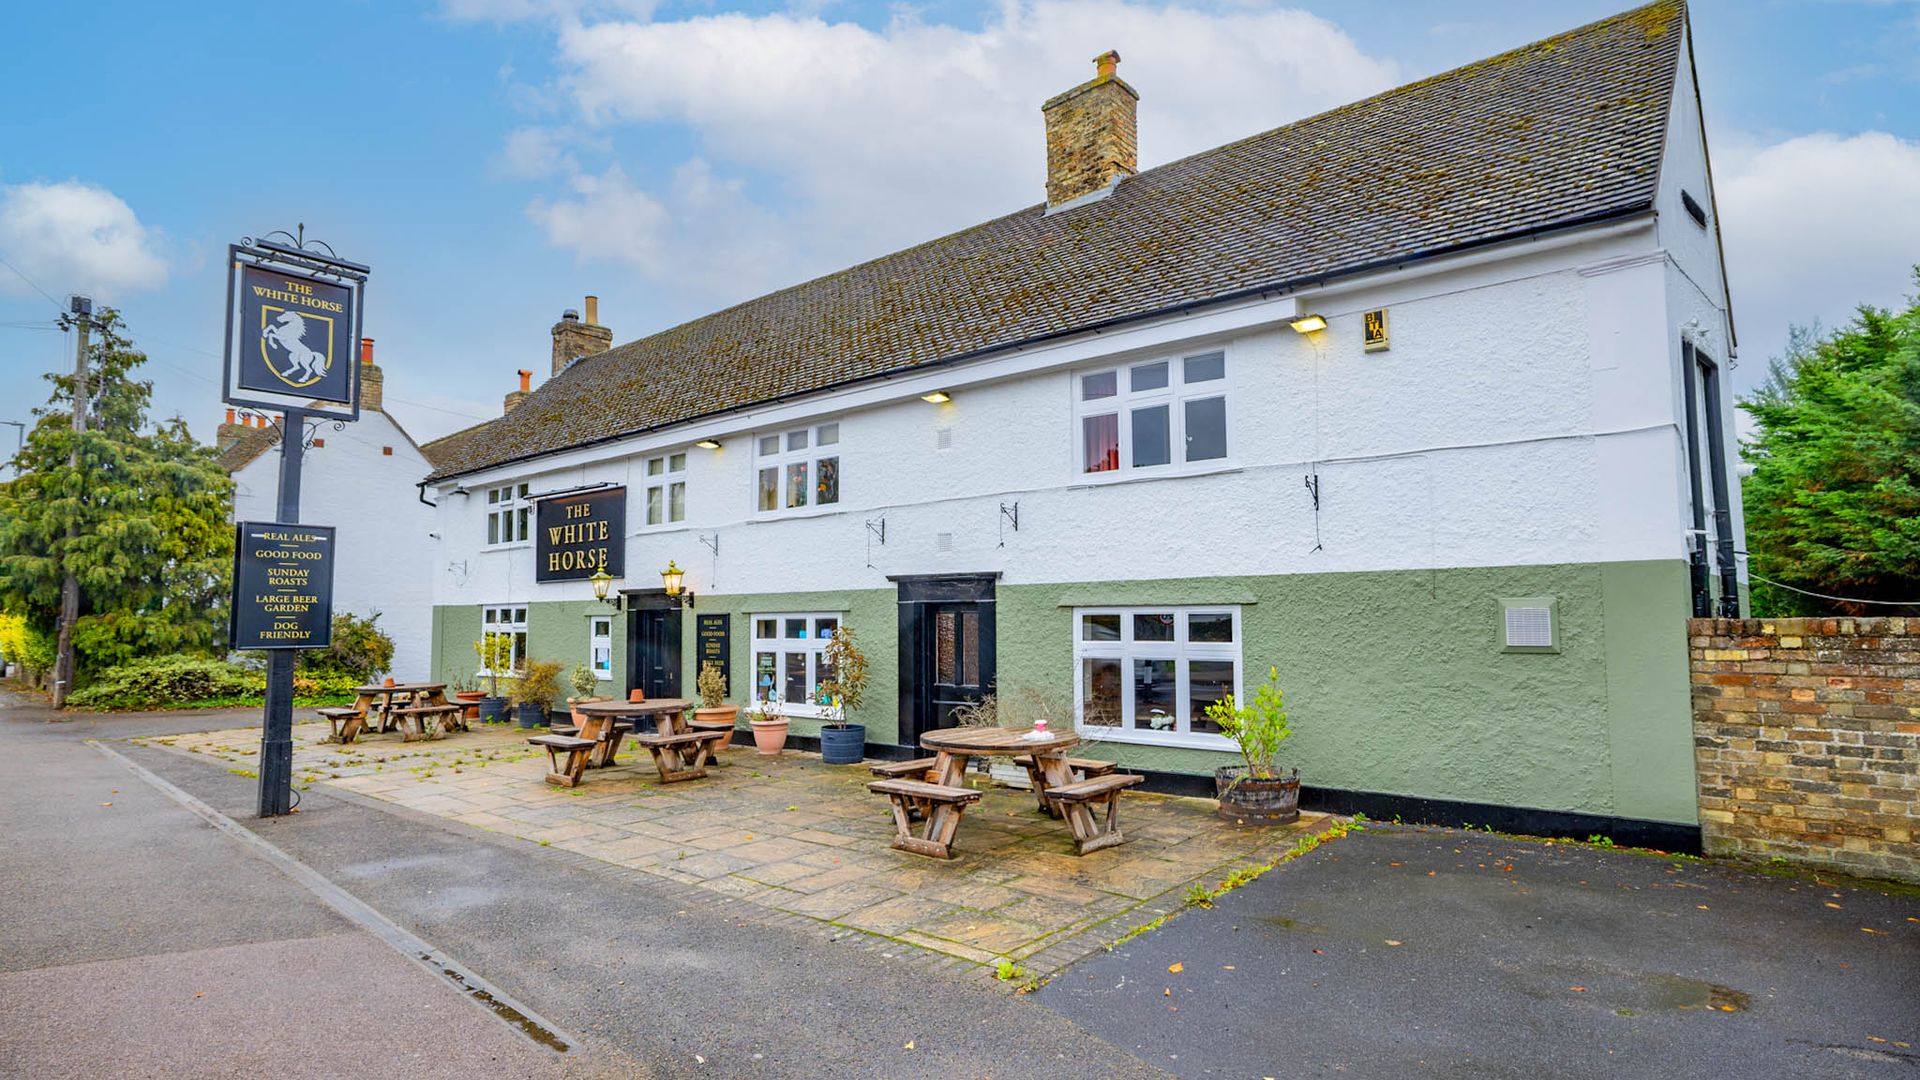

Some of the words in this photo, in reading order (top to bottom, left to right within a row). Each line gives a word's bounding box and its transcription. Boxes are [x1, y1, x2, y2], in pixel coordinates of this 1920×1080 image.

[285, 281, 313, 295] THE
[252, 286, 299, 304] WHITE
[301, 296, 343, 313] HORSE
[566, 503, 590, 518] THE
[264, 532, 289, 540] REAL
[292, 534, 316, 542] ALES
[548, 520, 609, 546] WHITE
[255, 550, 289, 559] GOOD
[292, 551, 322, 560] FOOD
[549, 548, 608, 571] HORSE
[267, 568, 310, 577] SUNDAY
[268, 578, 308, 586] ROASTS
[255, 595, 290, 603] LARGE
[293, 595, 318, 604] BEER
[264, 604, 309, 612] GARDEN
[273, 622, 298, 630] DOG
[260, 631, 311, 639] FRIENDLY
